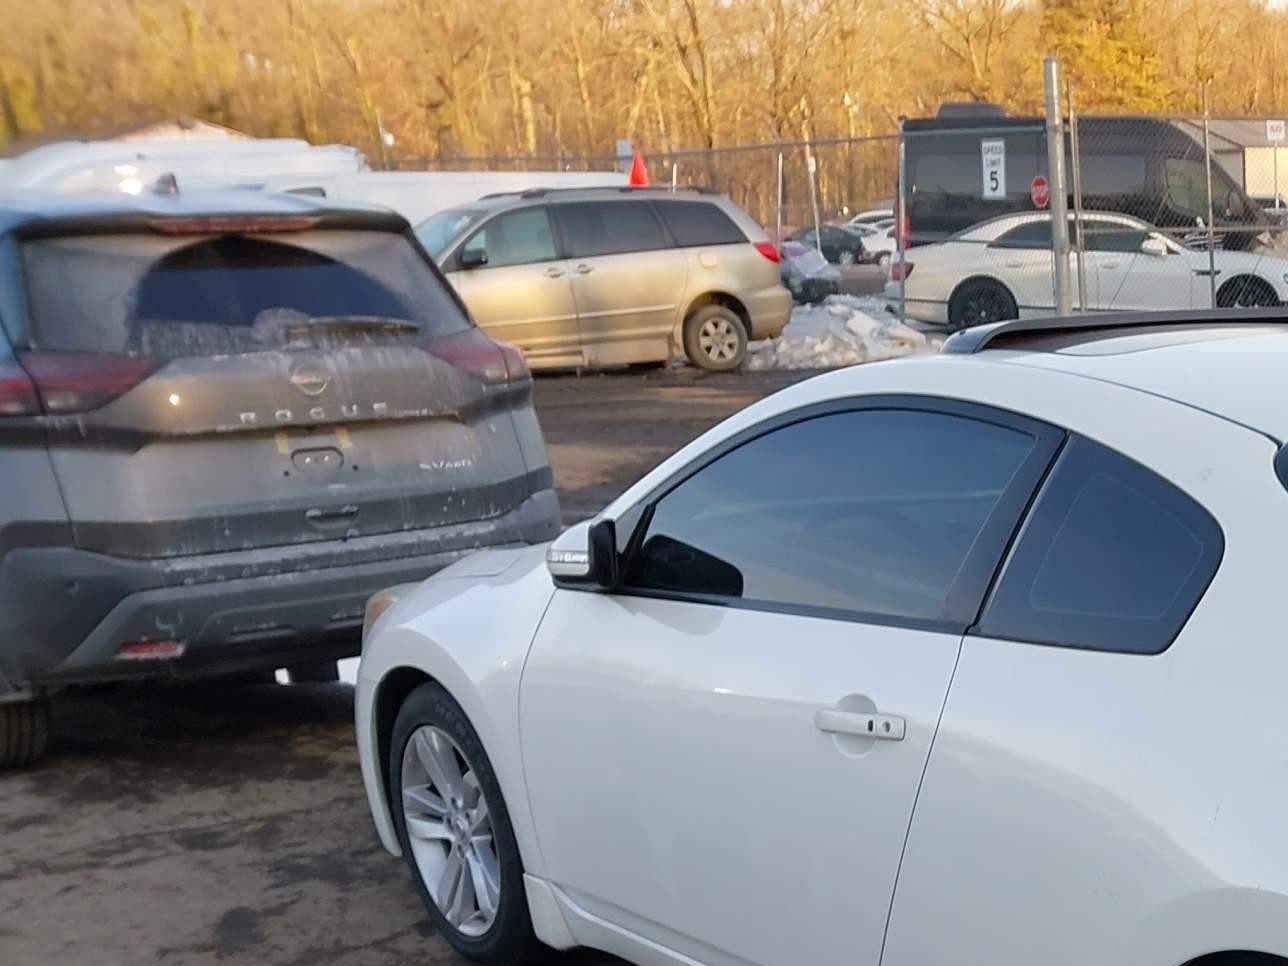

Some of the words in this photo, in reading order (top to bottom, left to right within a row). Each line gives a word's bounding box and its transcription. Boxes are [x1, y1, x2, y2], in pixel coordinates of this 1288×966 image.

[983, 145, 1003, 155] SPEED
[989, 170, 999, 192] 5
[239, 401, 388, 424] ROGUE
